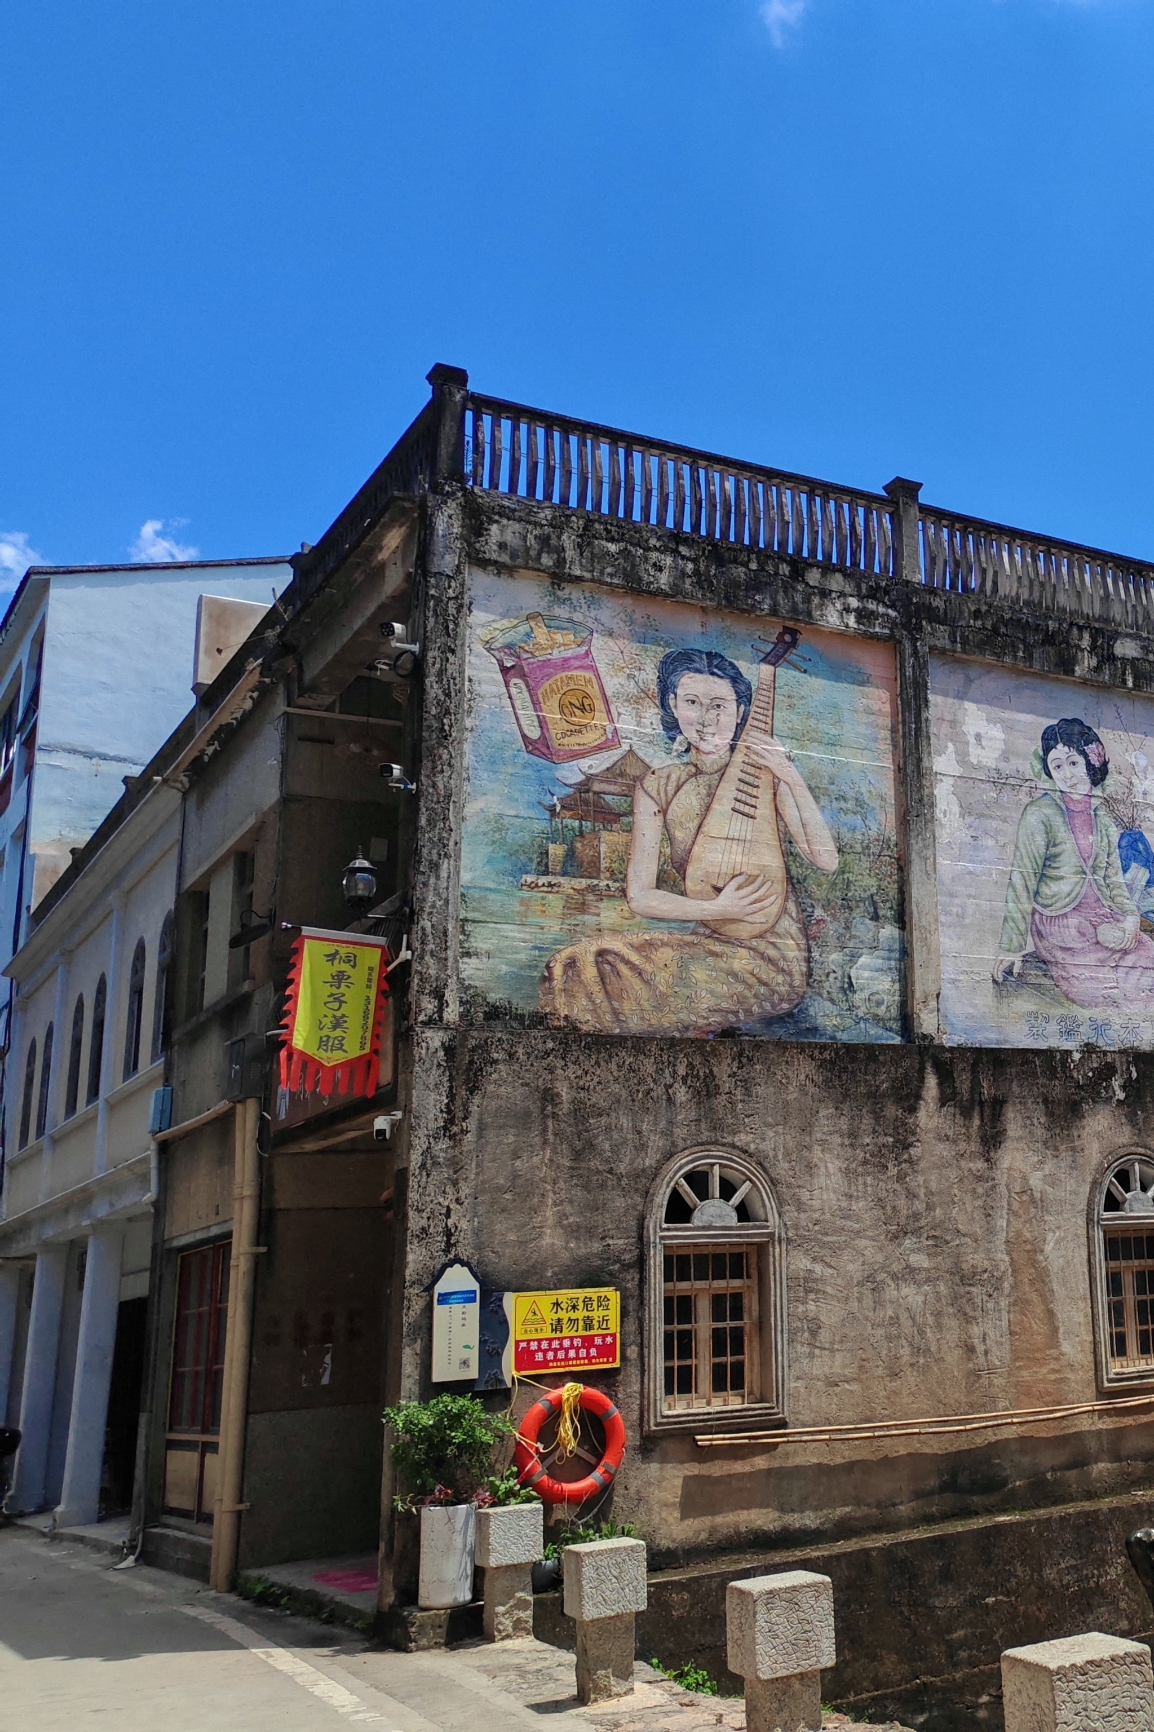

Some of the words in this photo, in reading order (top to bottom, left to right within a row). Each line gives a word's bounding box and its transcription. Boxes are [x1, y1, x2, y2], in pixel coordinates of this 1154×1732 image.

[317, 949, 359, 1054] 桐栗子漢服
[550, 1295, 611, 1315] 水深危险
[550, 1315, 611, 1335] 请勿靠近
[518, 1336, 614, 1351] 严禁在此垂钓、玩水
[535, 1348, 598, 1361] 违者后果自负
